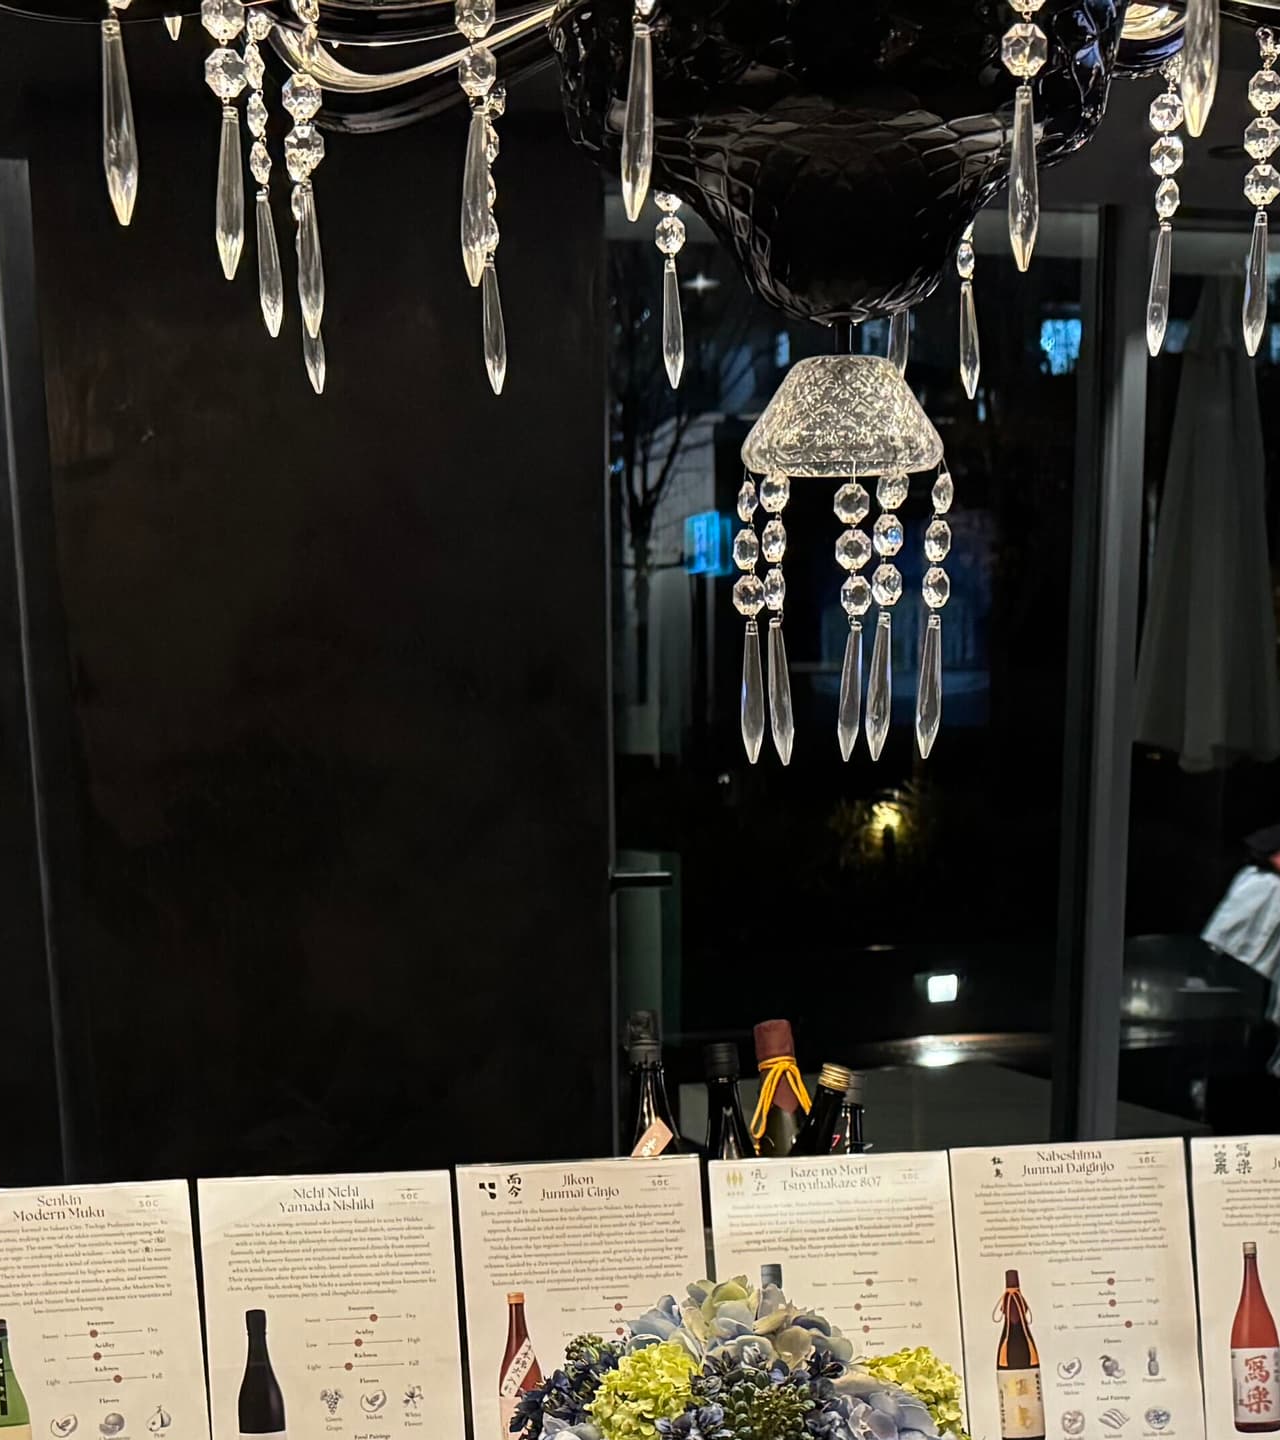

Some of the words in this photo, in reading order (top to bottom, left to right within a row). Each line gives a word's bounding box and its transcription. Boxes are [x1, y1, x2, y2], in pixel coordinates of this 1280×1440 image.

[1037, 1150, 1101, 1161] Nabeshima
[791, 1168, 818, 1180] Kaze
[821, 1168, 837, 1179] no
[840, 1164, 867, 1175] Mori
[1022, 1164, 1063, 1176] Junmai
[1066, 1162, 1114, 1175] Daiginjo
[563, 1174, 595, 1188] Jikon
[860, 1176, 881, 1187] 807
[294, 1187, 324, 1198] Nichi
[328, 1185, 358, 1197] Nichi
[541, 1185, 583, 1201] Junmai
[587, 1187, 619, 1200] Ginjo
[37, 1194, 81, 1209] Senkin
[280, 1200, 330, 1212] Yamada
[334, 1198, 374, 1210] Nishiki
[13, 1209, 65, 1221] Modern
[69, 1207, 104, 1218] Muku
